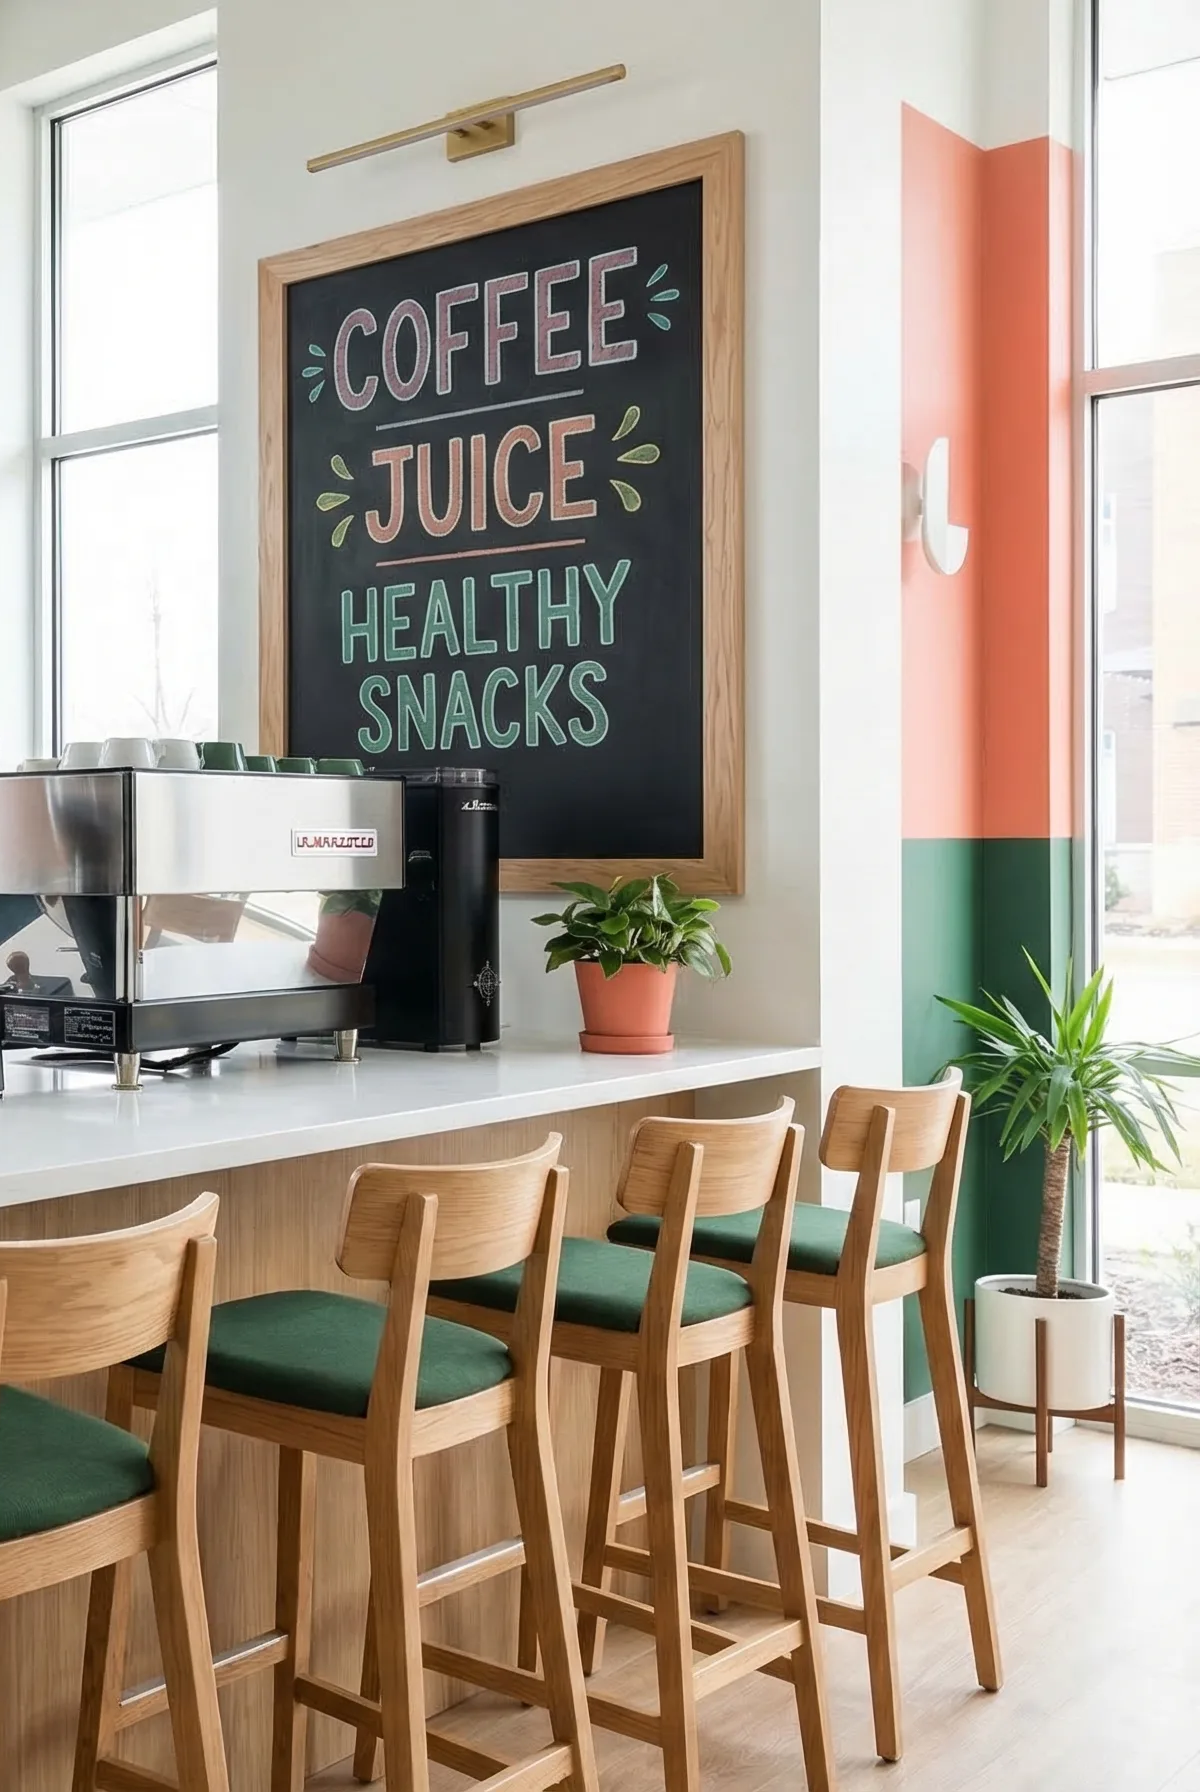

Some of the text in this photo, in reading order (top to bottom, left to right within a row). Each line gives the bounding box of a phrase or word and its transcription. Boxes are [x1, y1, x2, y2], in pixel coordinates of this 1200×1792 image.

[333, 246, 638, 411] COFFEE
[364, 414, 597, 543] JUICE
[341, 559, 631, 664] HEALTHY
[357, 660, 609, 753] SNACKS
